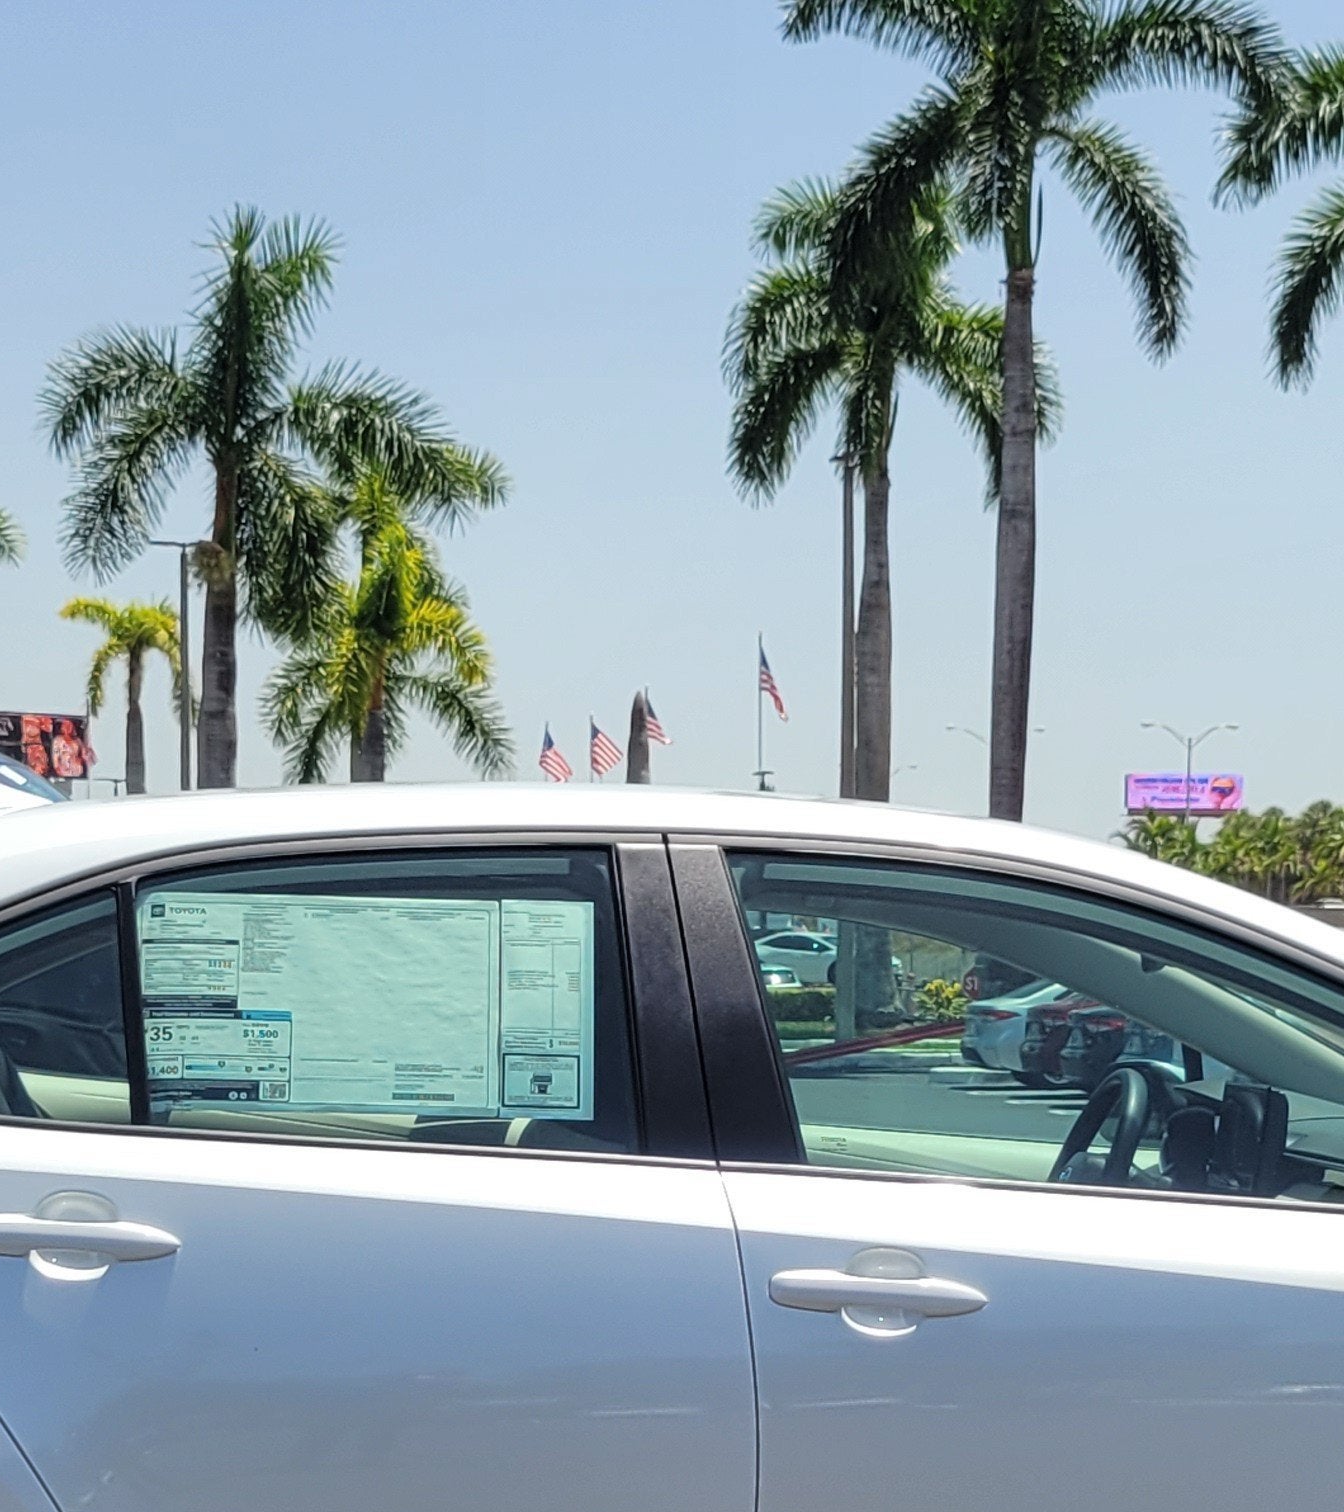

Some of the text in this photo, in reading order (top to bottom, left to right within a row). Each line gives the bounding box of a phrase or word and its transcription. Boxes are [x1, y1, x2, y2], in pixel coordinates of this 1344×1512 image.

[168, 906, 207, 915] TOYOTA
[149, 1026, 173, 1042] 35
[147, 1066, 179, 1076] 1,400
